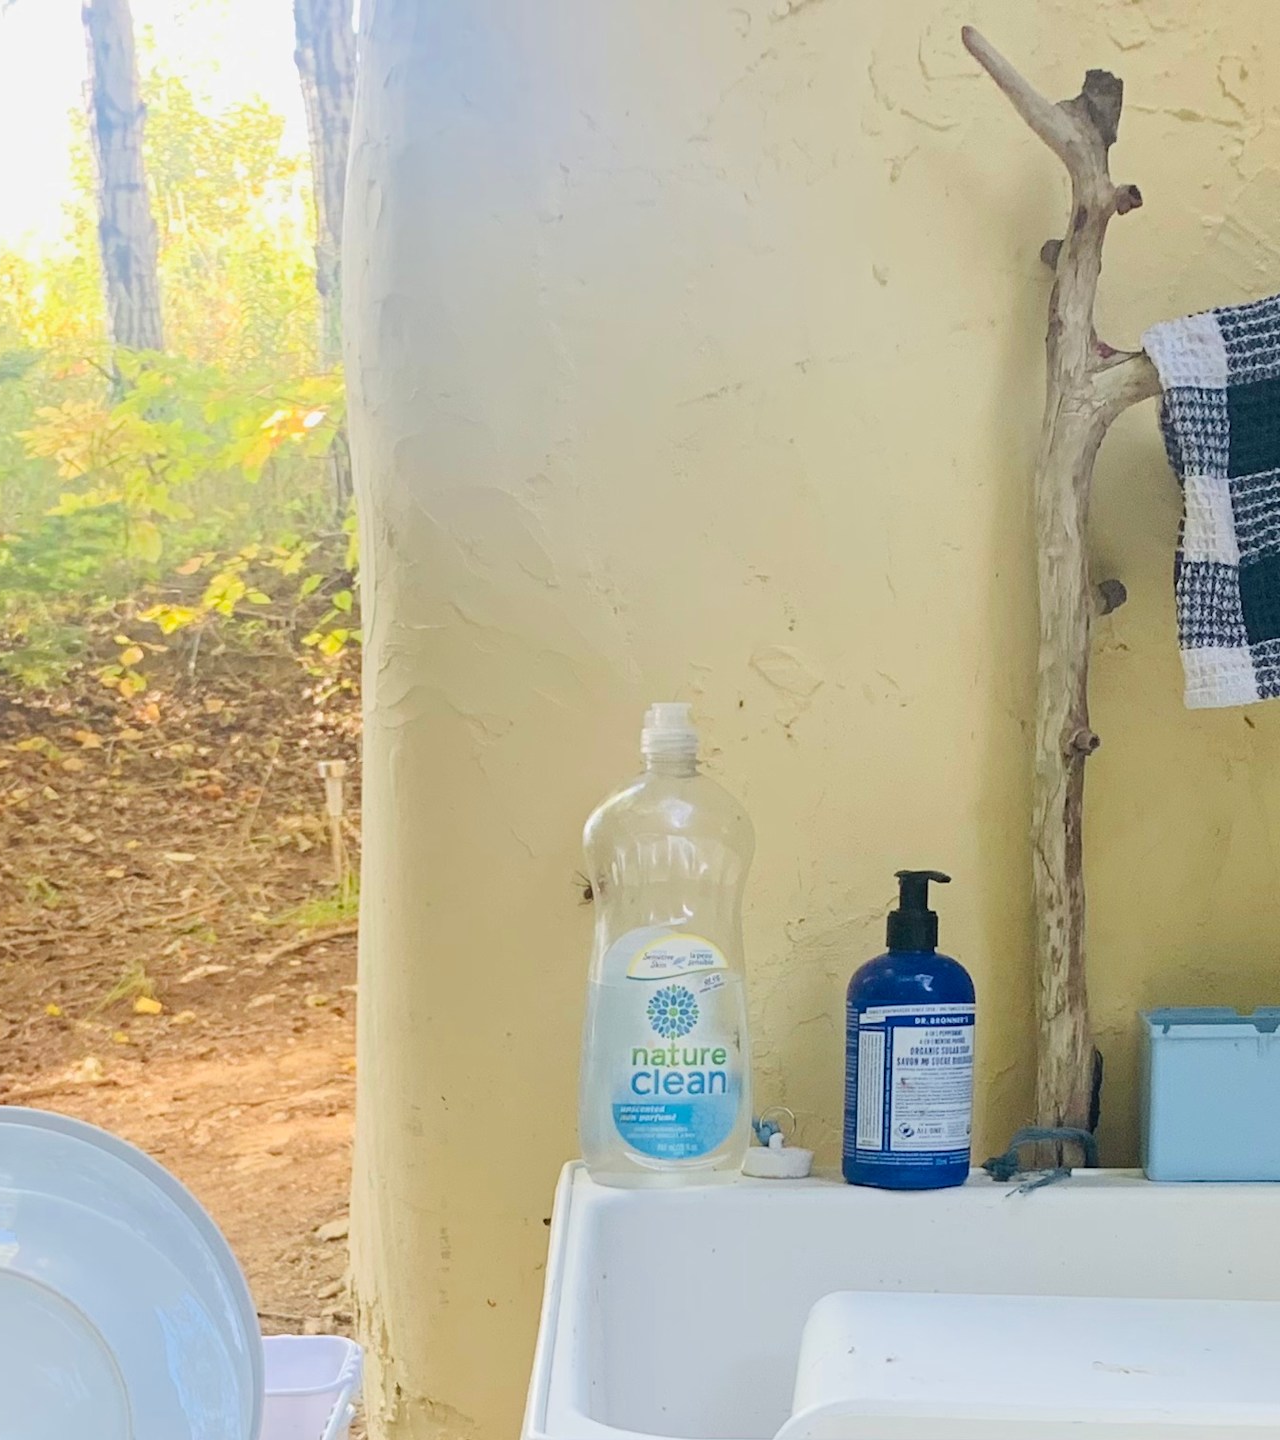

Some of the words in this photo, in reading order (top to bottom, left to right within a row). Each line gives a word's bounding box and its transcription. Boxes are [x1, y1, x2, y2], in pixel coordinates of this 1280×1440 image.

[914, 1016, 929, 1025] DR.
[929, 1015, 969, 1025] BRONNER'S
[631, 1041, 727, 1067] nature
[910, 1046, 940, 1055] ORGANIC
[896, 1056, 919, 1066] SAVON
[631, 1069, 727, 1096] clean
[619, 1105, 666, 1113] unscented
